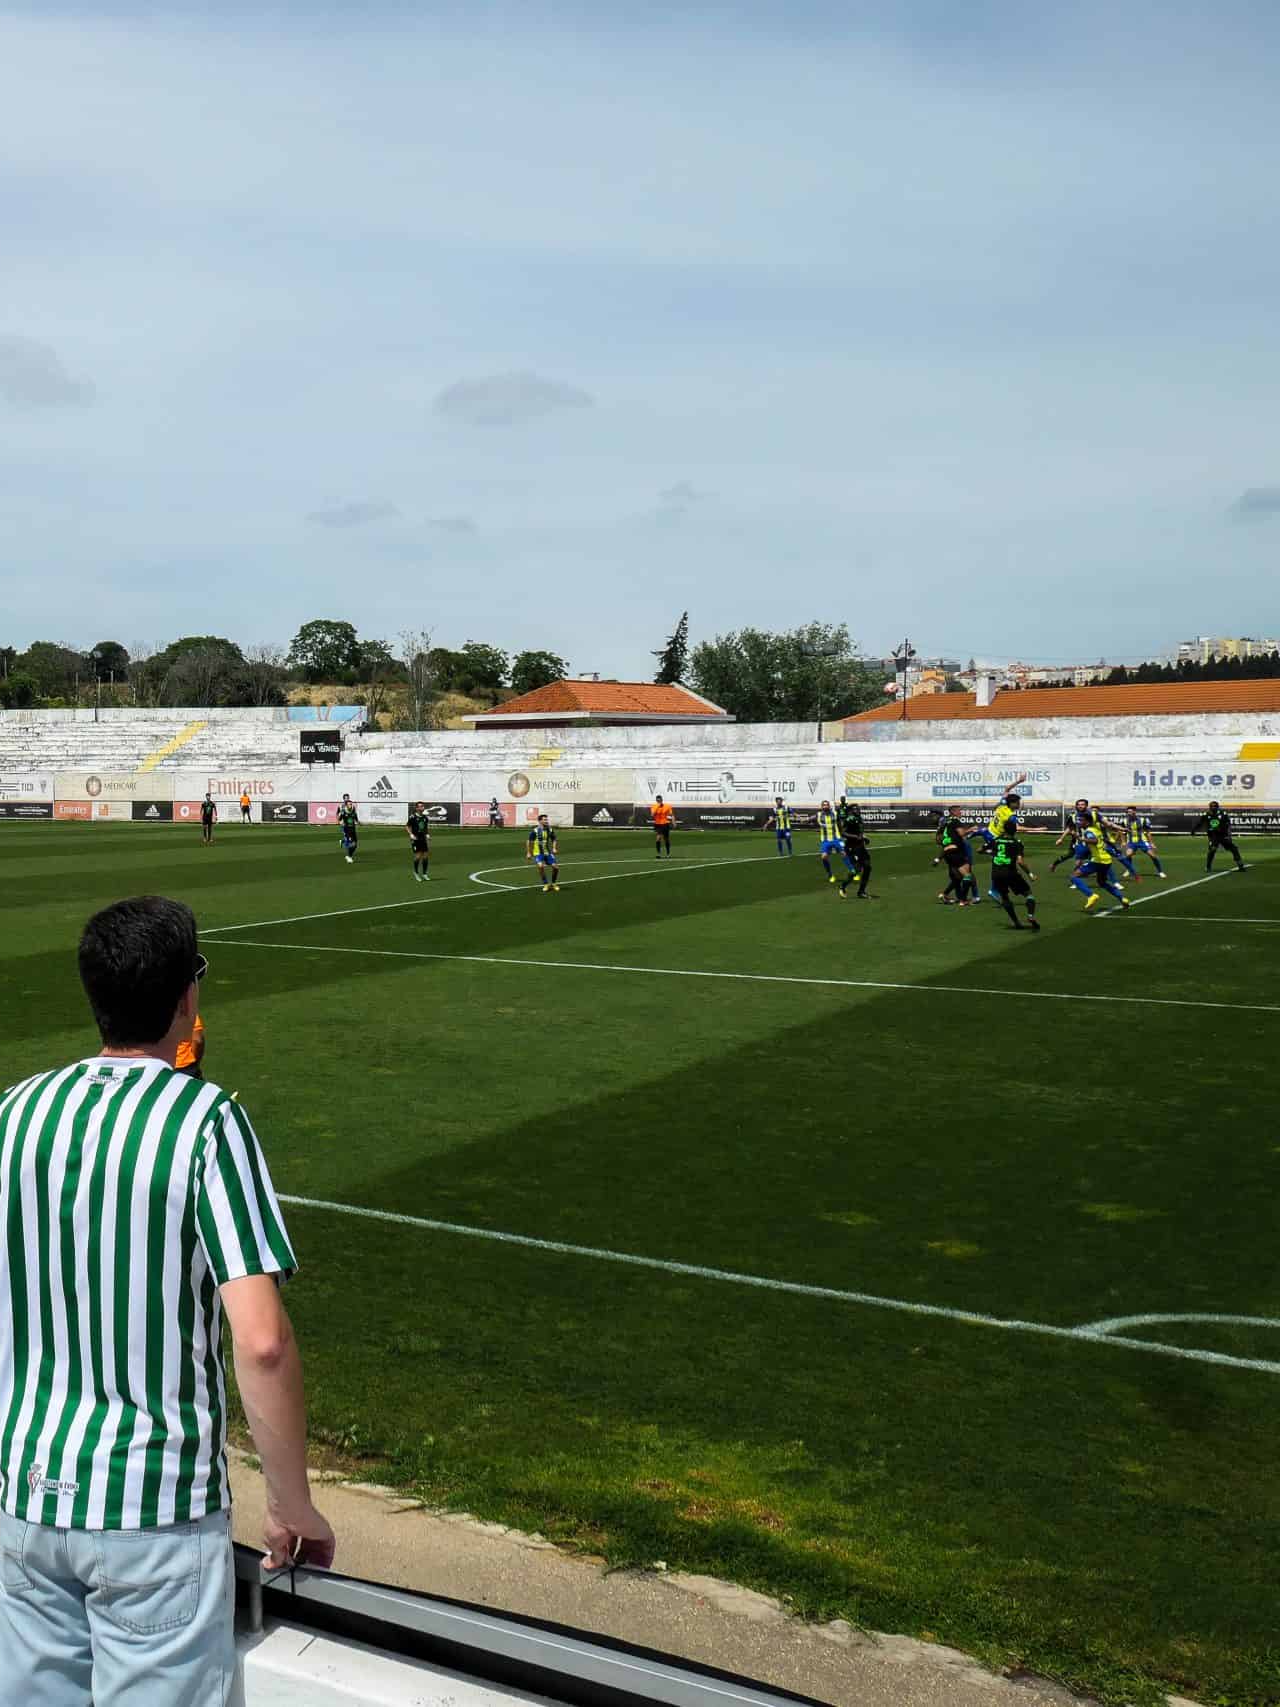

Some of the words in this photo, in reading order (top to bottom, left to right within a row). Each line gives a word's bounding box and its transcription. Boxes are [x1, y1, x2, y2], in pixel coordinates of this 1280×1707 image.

[916, 772, 982, 782] FORTUNATO
[996, 770, 1051, 782] ANTNES
[1133, 769, 1256, 790] hidroerg
[207, 777, 274, 795] Emirates
[533, 780, 582, 791] MEDICARE
